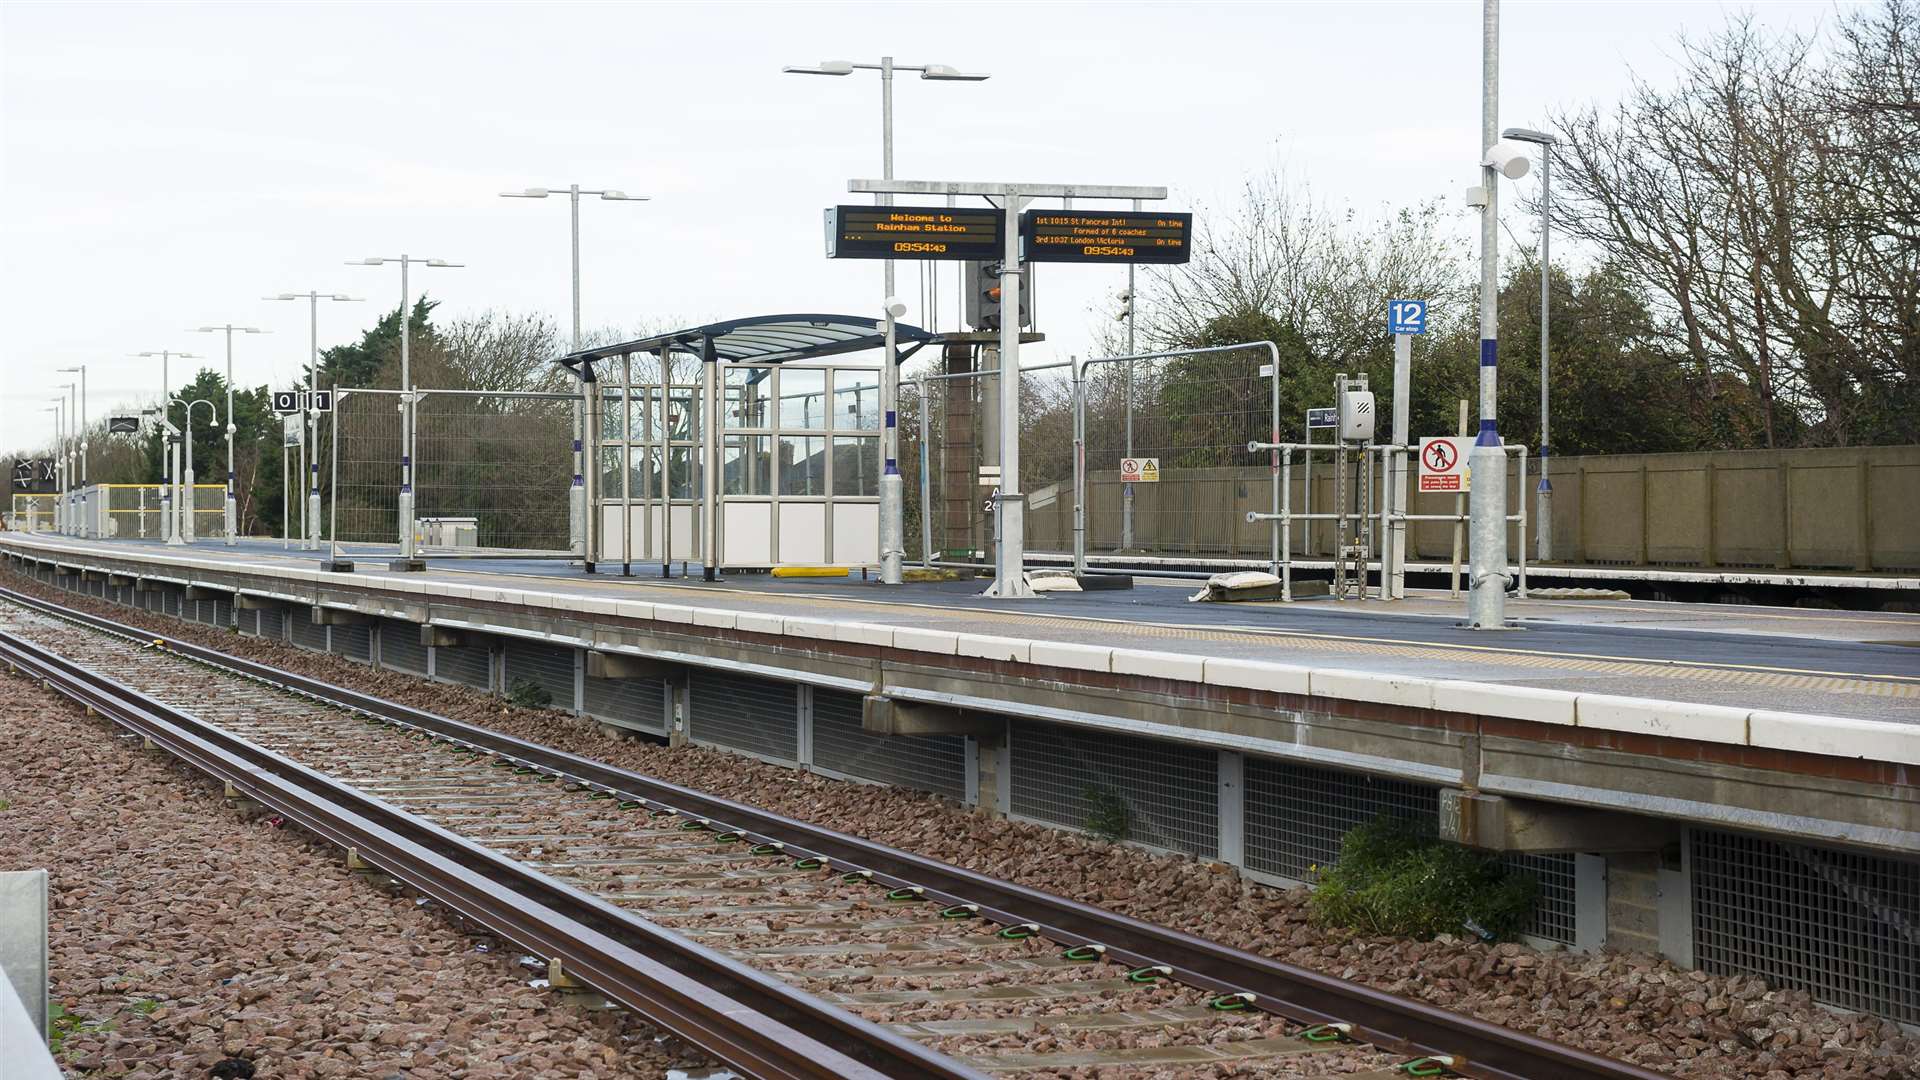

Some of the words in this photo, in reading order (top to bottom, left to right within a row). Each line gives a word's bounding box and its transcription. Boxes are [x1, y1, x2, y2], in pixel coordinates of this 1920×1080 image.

[890, 214, 934, 222] Welcome
[940, 214, 952, 222] to
[1036, 217, 1048, 225] 1st
[1051, 217, 1069, 225] 1015
[1071, 217, 1079, 225] St
[1082, 218, 1109, 226] Pancras
[876, 223, 920, 232] Rainham
[924, 223, 966, 232] Station
[1157, 219, 1166, 227] On
[1169, 220, 1182, 228] time
[1097, 237, 1125, 245] Victoria
[894, 242, 946, 252] 09:54:43
[1083, 246, 1134, 256] 09:54:43
[1393, 303, 1422, 325] 12
[279, 394, 290, 407] 0
[316, 394, 322, 407] 1
